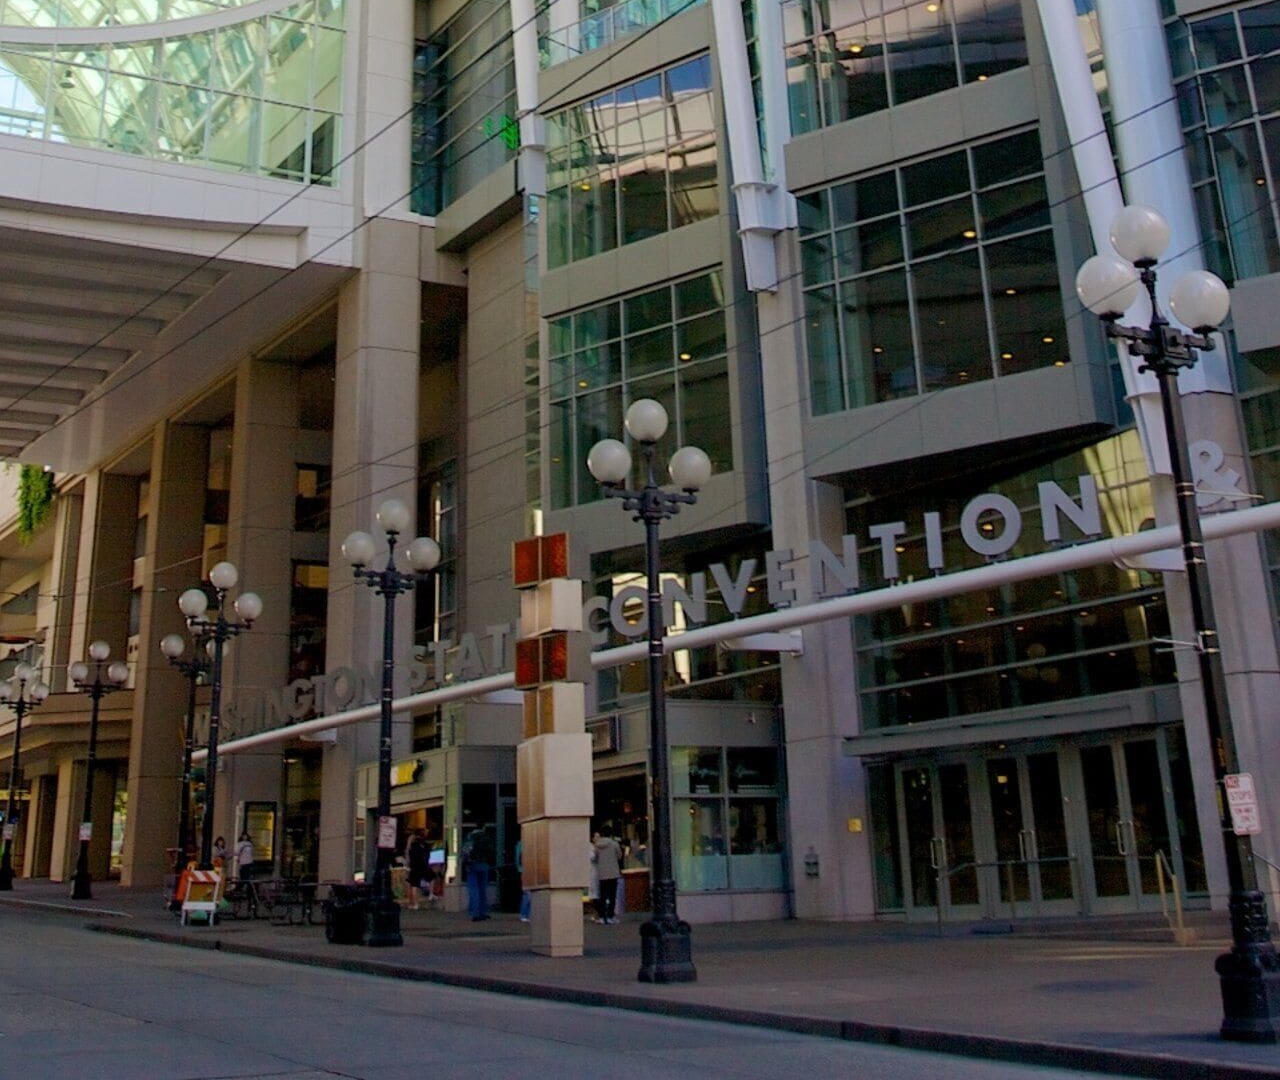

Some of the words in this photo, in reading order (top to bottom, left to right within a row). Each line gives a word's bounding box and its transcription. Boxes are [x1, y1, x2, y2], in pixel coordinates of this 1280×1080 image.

[407, 622, 516, 689] STAT
[582, 474, 1103, 645] CONVENTION
[1189, 439, 1246, 508] &
